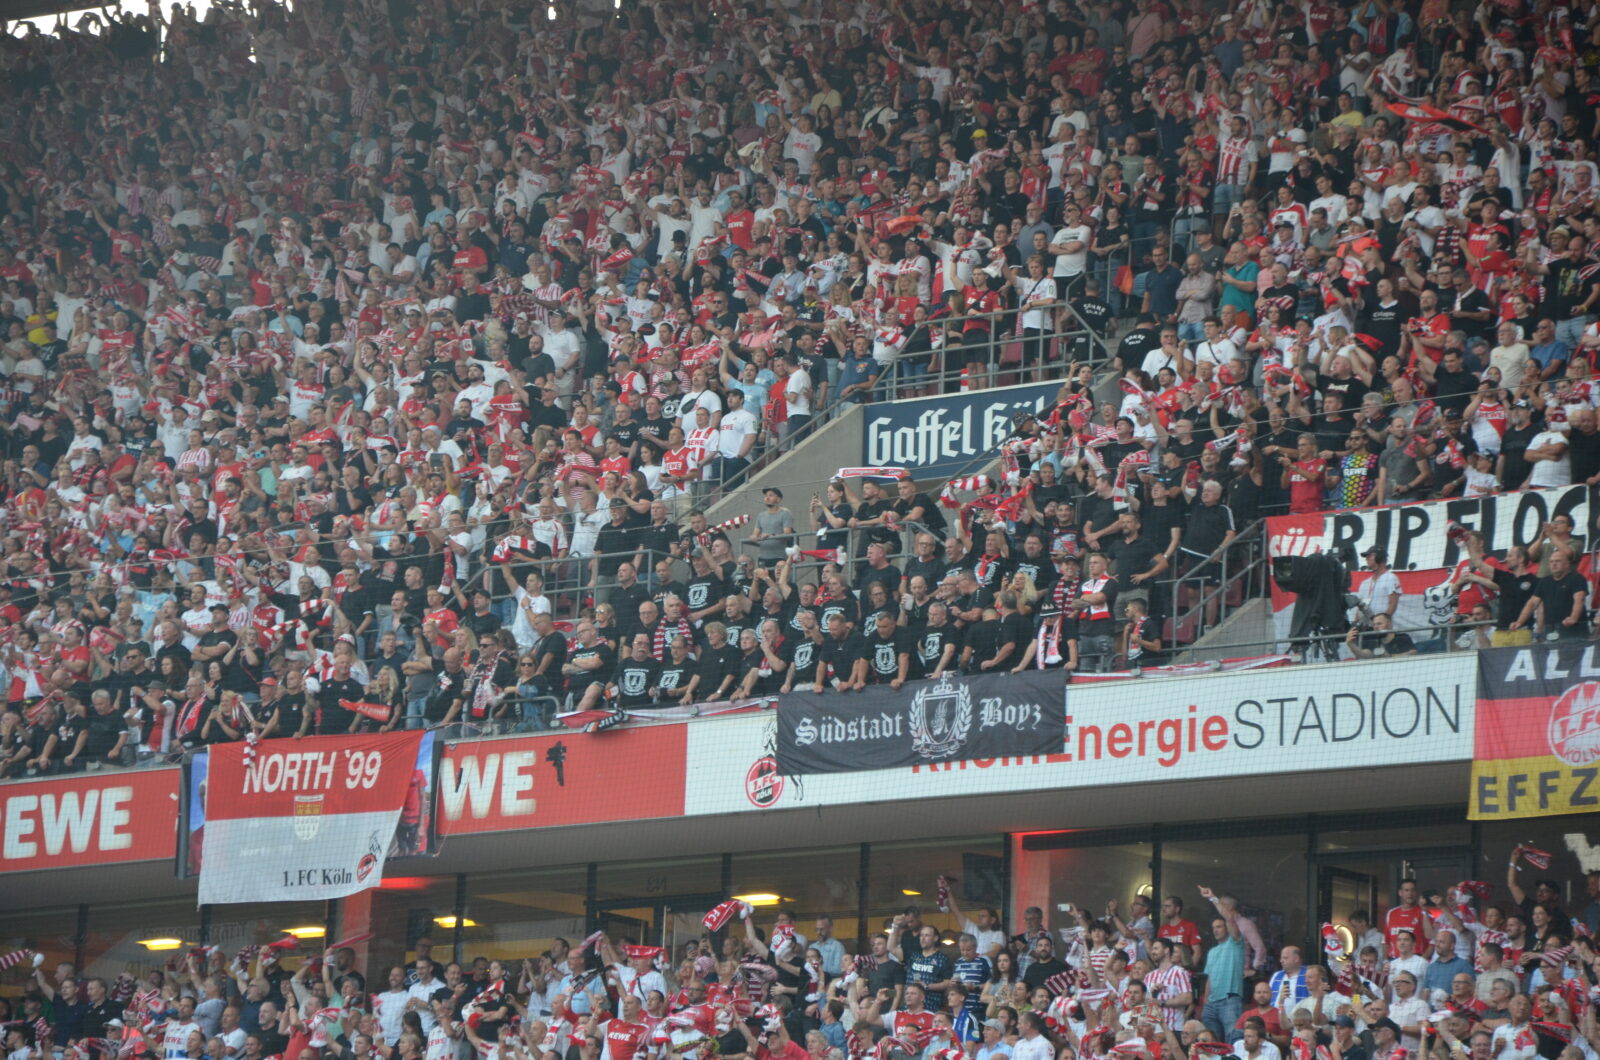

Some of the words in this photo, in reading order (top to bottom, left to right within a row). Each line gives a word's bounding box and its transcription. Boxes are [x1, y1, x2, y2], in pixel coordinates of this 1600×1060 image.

[868, 405, 976, 467] Gaffel
[666, 462, 682, 470] REWE
[1343, 468, 1367, 476] REWE
[795, 711, 904, 746] Südstadt
[979, 696, 1042, 732] Boyz
[242, 751, 337, 794] NORTH
[756, 786, 773, 801] KÖLN
[1478, 768, 1598, 814] EFFZ
[0, 786, 133, 859] EWE
[283, 871, 293, 887] 1.
[298, 869, 317, 886] FC
[322, 868, 352, 885] Köln
[912, 963, 934, 973] REWE
[608, 1032, 630, 1042] REWE
